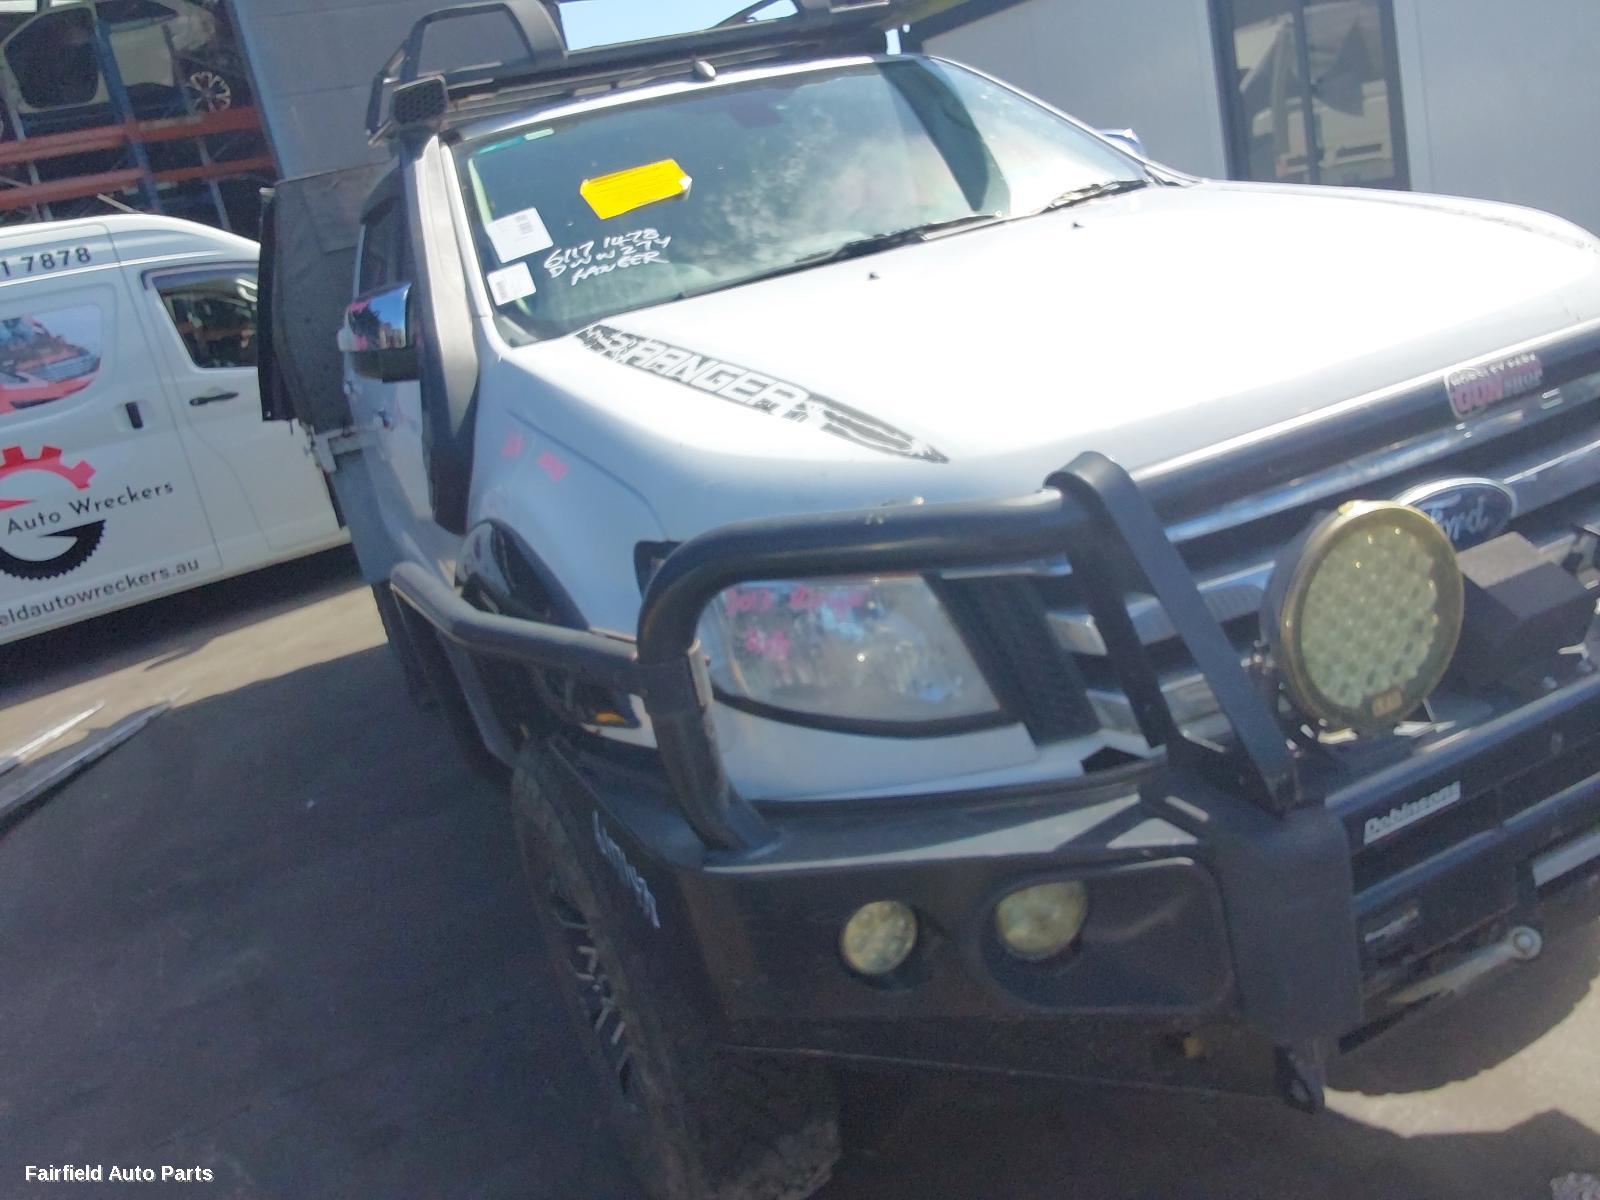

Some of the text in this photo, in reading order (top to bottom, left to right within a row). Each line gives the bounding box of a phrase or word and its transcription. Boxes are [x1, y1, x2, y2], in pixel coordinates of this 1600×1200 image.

[20, 246, 92, 273] 7878
[7, 481, 174, 535] Auto Wreckers
